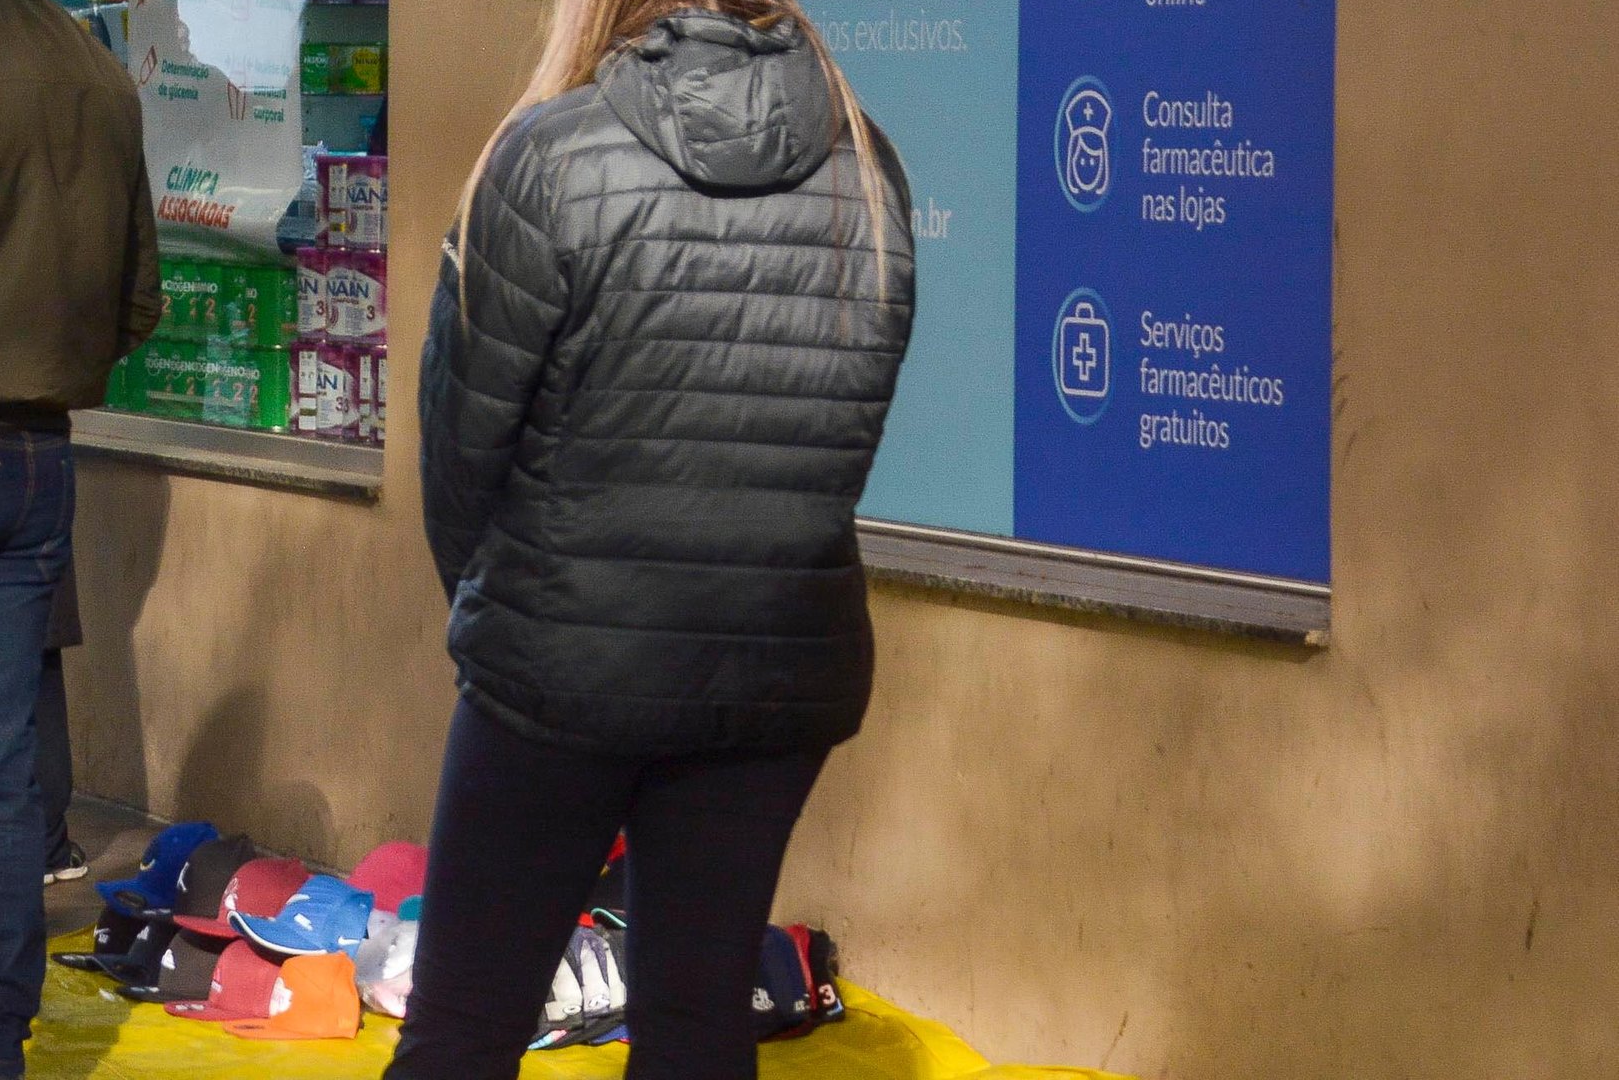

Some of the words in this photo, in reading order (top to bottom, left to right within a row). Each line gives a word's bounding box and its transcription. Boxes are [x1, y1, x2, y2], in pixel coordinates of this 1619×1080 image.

[854, 8, 968, 52] exclusivos.
[1143, 90, 1233, 129] Consulta
[1142, 137, 1276, 178] farmacêutica
[167, 161, 220, 196] CLÍNICA
[157, 195, 236, 230] ASSOCIADAS
[1142, 193, 1176, 221] nas
[1180, 185, 1227, 232] lojas
[1140, 310, 1226, 360] Serviços
[1140, 357, 1284, 406] farmacêuticos
[1139, 408, 1231, 449] gratuitos
